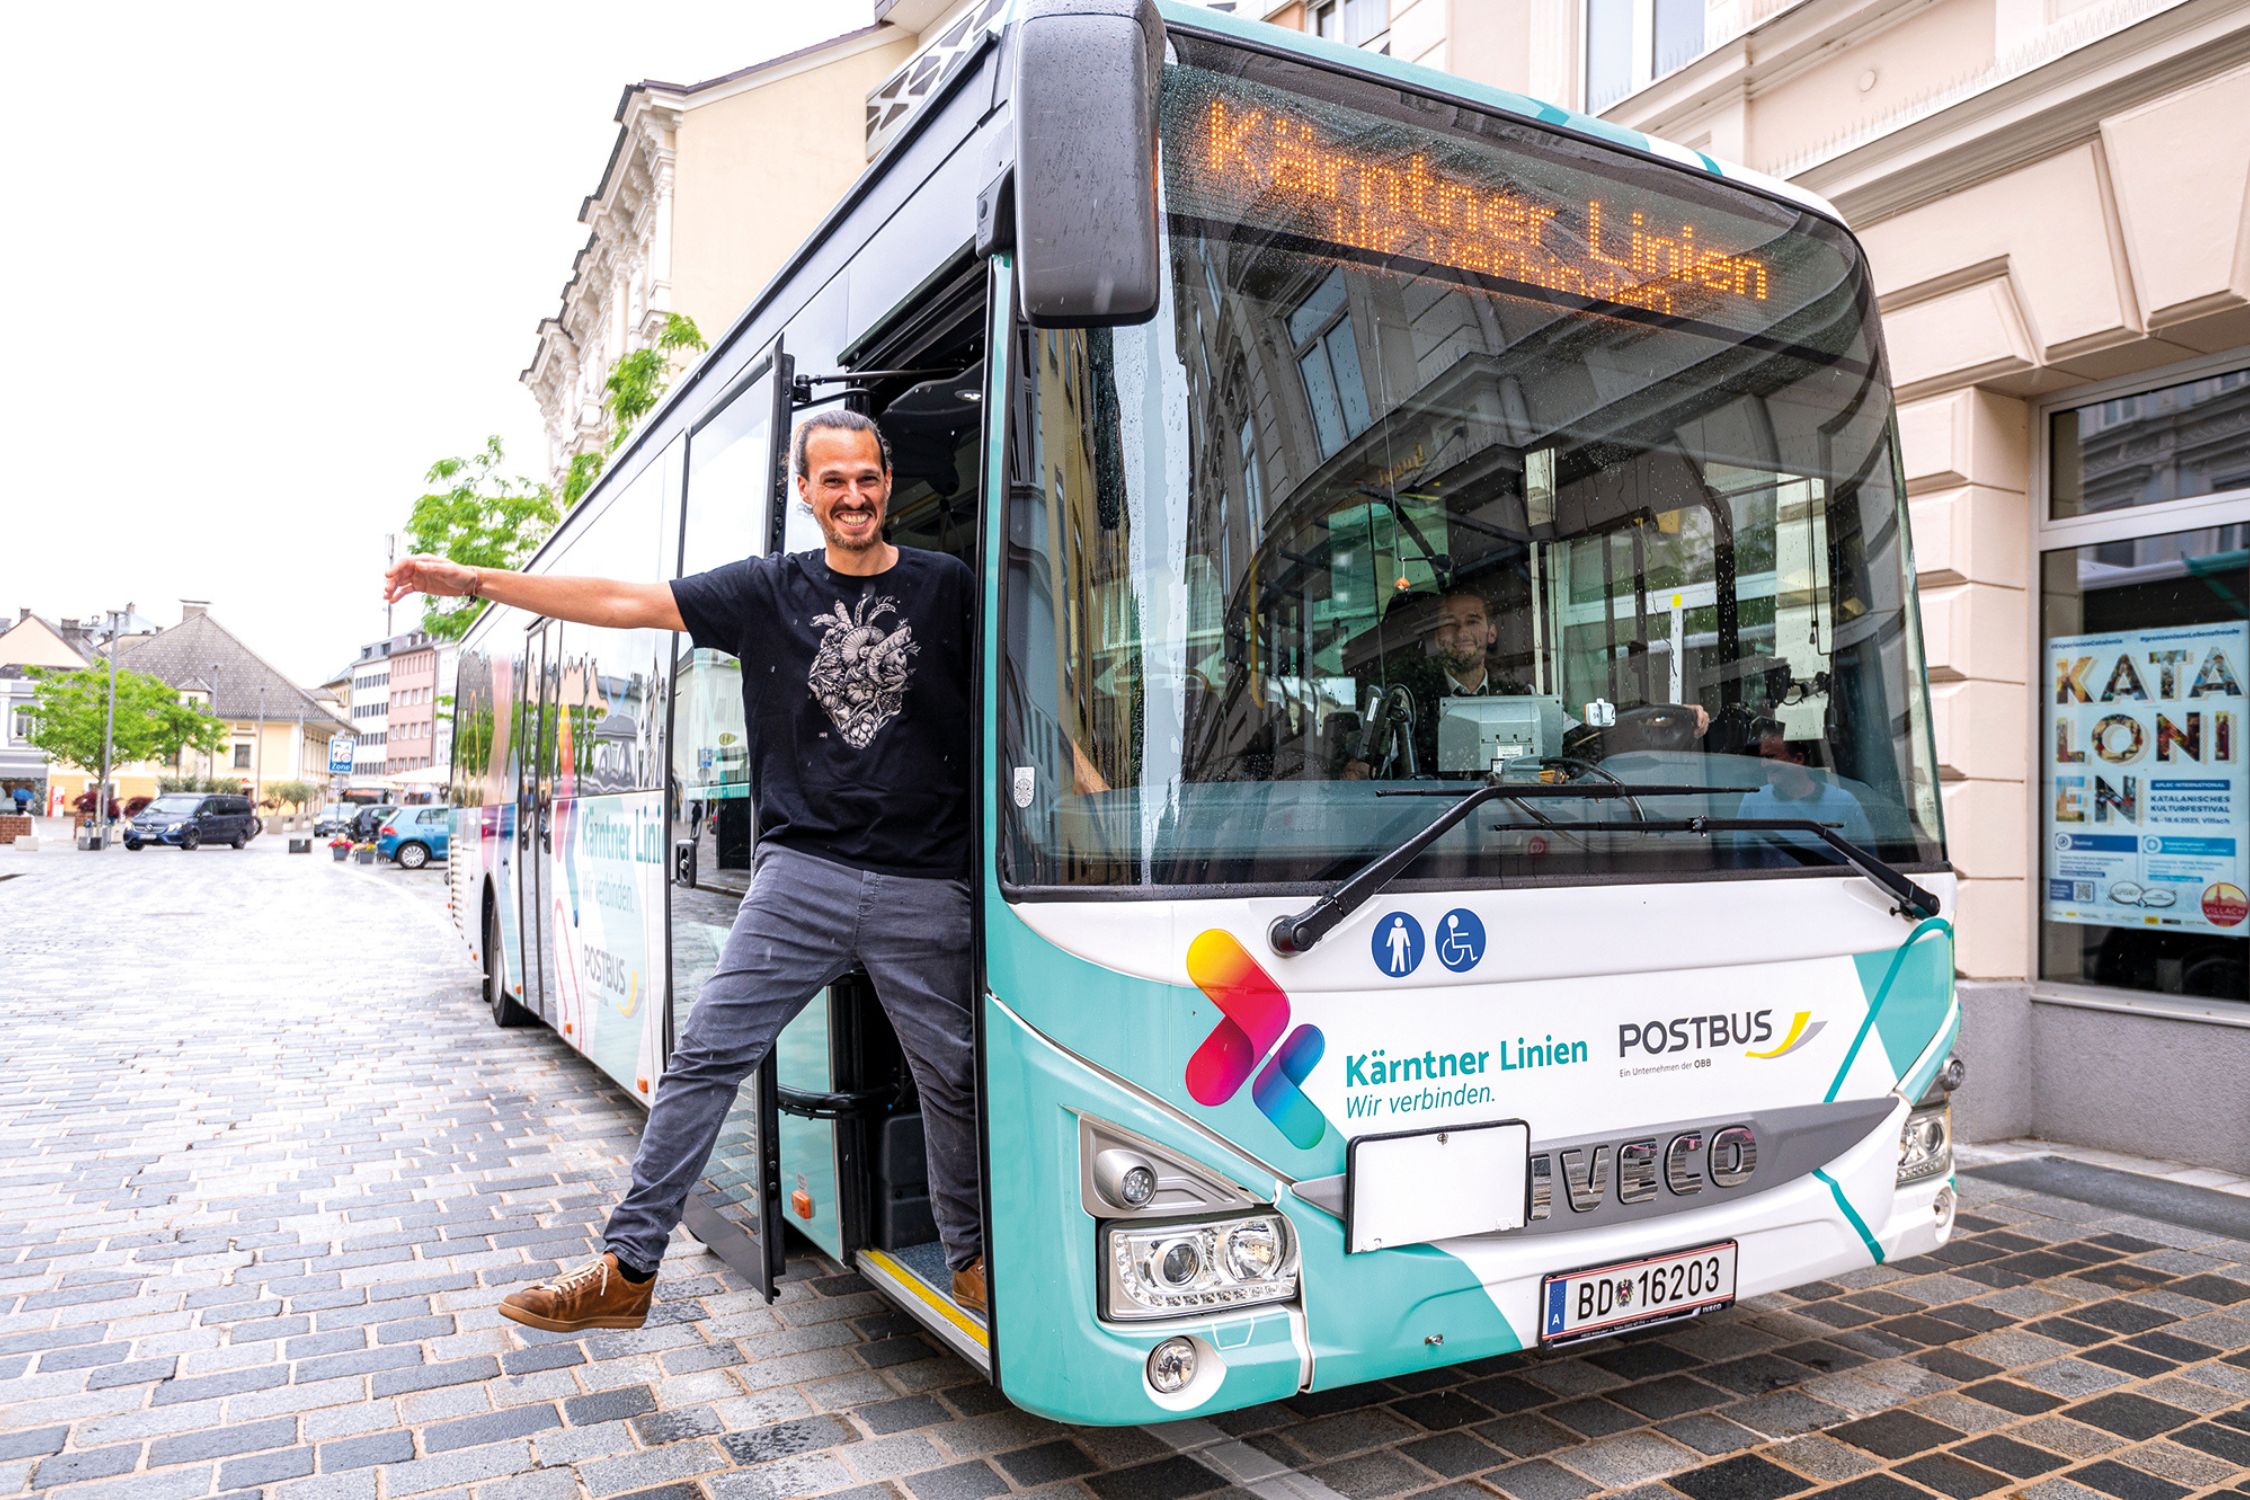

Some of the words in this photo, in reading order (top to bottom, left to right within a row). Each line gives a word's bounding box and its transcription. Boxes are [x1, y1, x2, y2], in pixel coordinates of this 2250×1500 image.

[1210, 100, 1556, 245] Kärntner
[1588, 200, 1767, 300] Linien
[2056, 647, 2243, 705] KATA
[2056, 711, 2230, 764] LONI
[2056, 775, 2136, 824] EN
[2150, 795, 2230, 803] KATALANISCHES
[2150, 805, 2230, 813] KULTURFESTIVAL
[2204, 906, 2246, 916] VILLACH
[584, 943, 626, 996] POSTBUS
[1619, 1009, 1773, 1058] POSTBUS
[1346, 1049, 1490, 1088] Kärntner
[1500, 1034, 1588, 1071] Linien
[1619, 1068, 1631, 1077] Ein
[1632, 1064, 1680, 1076] Unternehmen
[1681, 1061, 1692, 1071] der
[1346, 1096, 1383, 1119] Wir
[1389, 1083, 1496, 1114] verbinden.
[1529, 1124, 1758, 1221] IVECO
[1577, 1278, 1614, 1321] BD
[1638, 1256, 1720, 1308] 16203
[1702, 1303, 1723, 1314] IVECO
[1551, 1313, 1561, 1326] A
